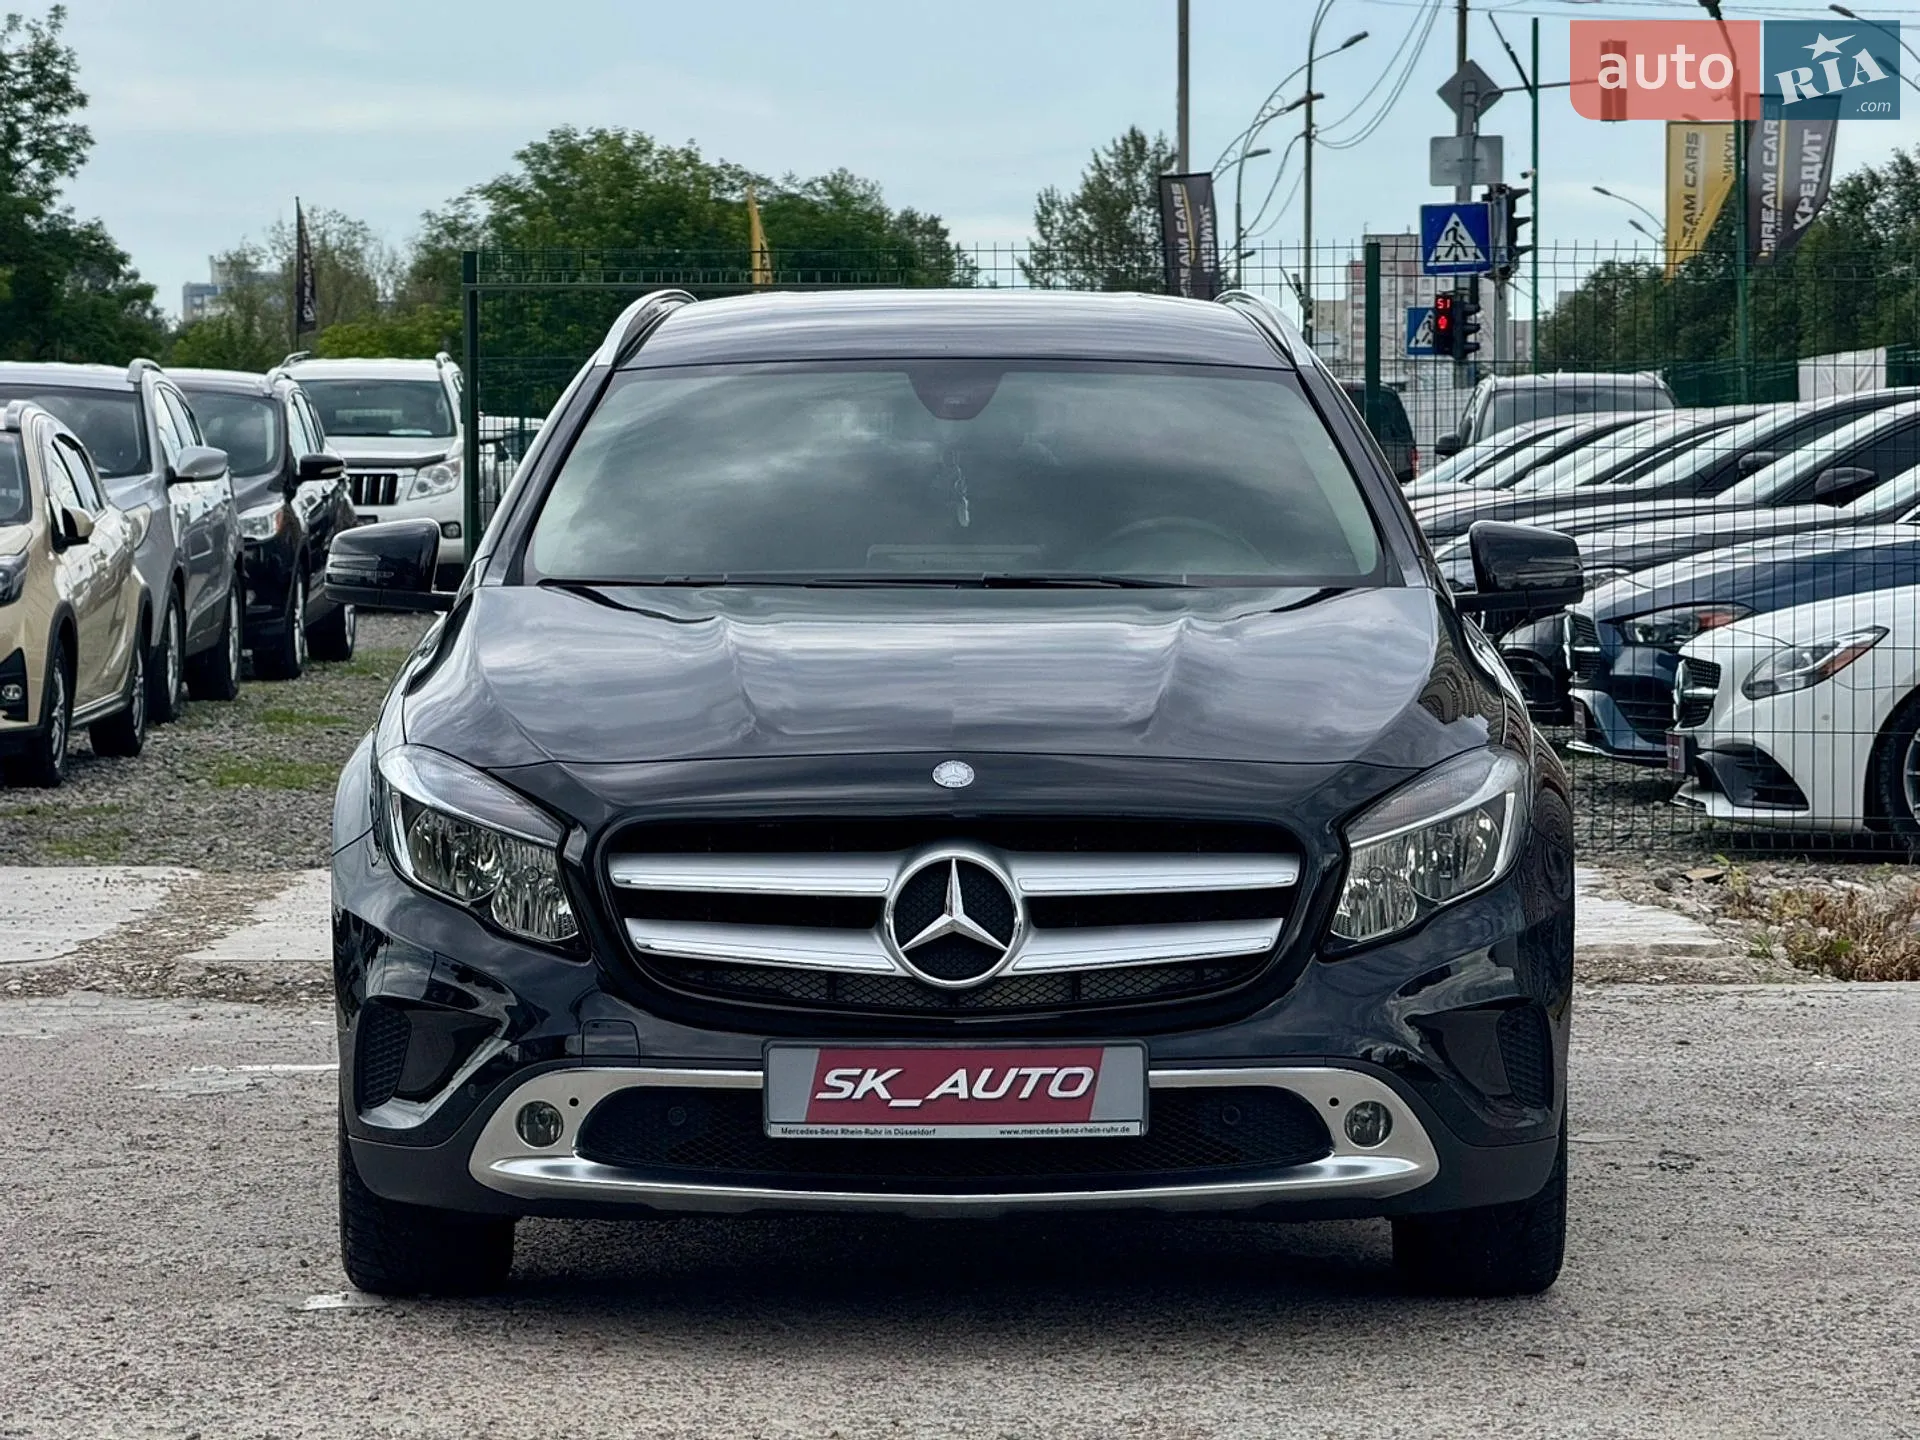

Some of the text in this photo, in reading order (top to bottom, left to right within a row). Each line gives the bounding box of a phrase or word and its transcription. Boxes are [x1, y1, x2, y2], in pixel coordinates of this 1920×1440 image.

[1682, 131, 1700, 188] CARS
[1793, 129, 1823, 232] КРЕДИТ
[1171, 183, 1188, 233] CARS
[1760, 174, 1779, 251] DREAM
[815, 1066, 1095, 1107] SK_AUTO
[781, 1126, 936, 1136] Mercedes-Benz Rhein-Ruhr in Düsseldorf
[999, 1126, 1130, 1136] www.mercedes-benz-rhein-ruhr.de
